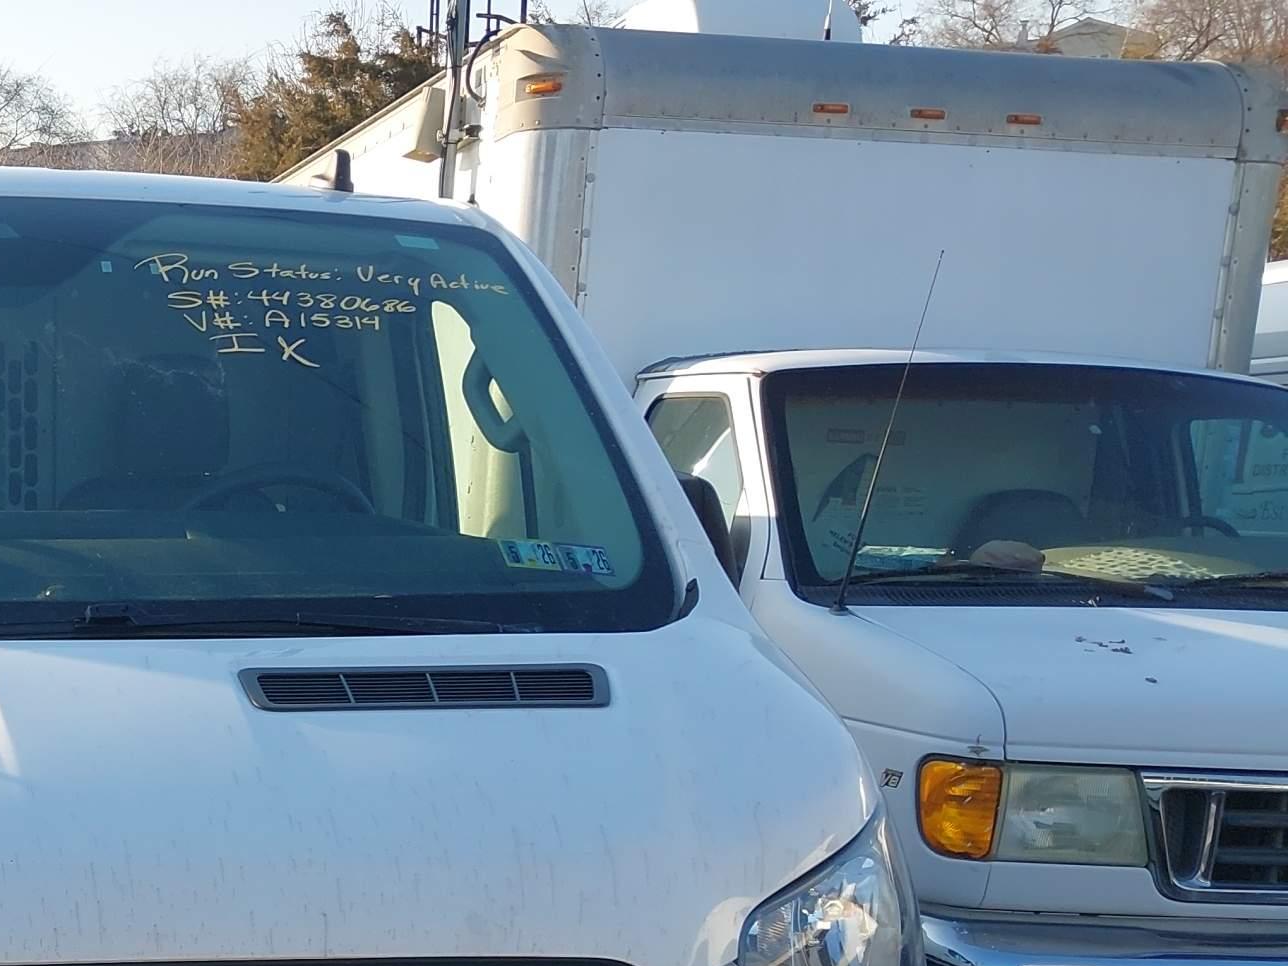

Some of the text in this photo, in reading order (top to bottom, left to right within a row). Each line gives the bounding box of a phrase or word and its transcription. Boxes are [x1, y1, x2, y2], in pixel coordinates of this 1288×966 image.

[134, 253, 509, 297] Run Status: Very Active
[264, 309, 380, 331] A15314
[536, 543, 557, 565] 26
[592, 549, 612, 570] 26
